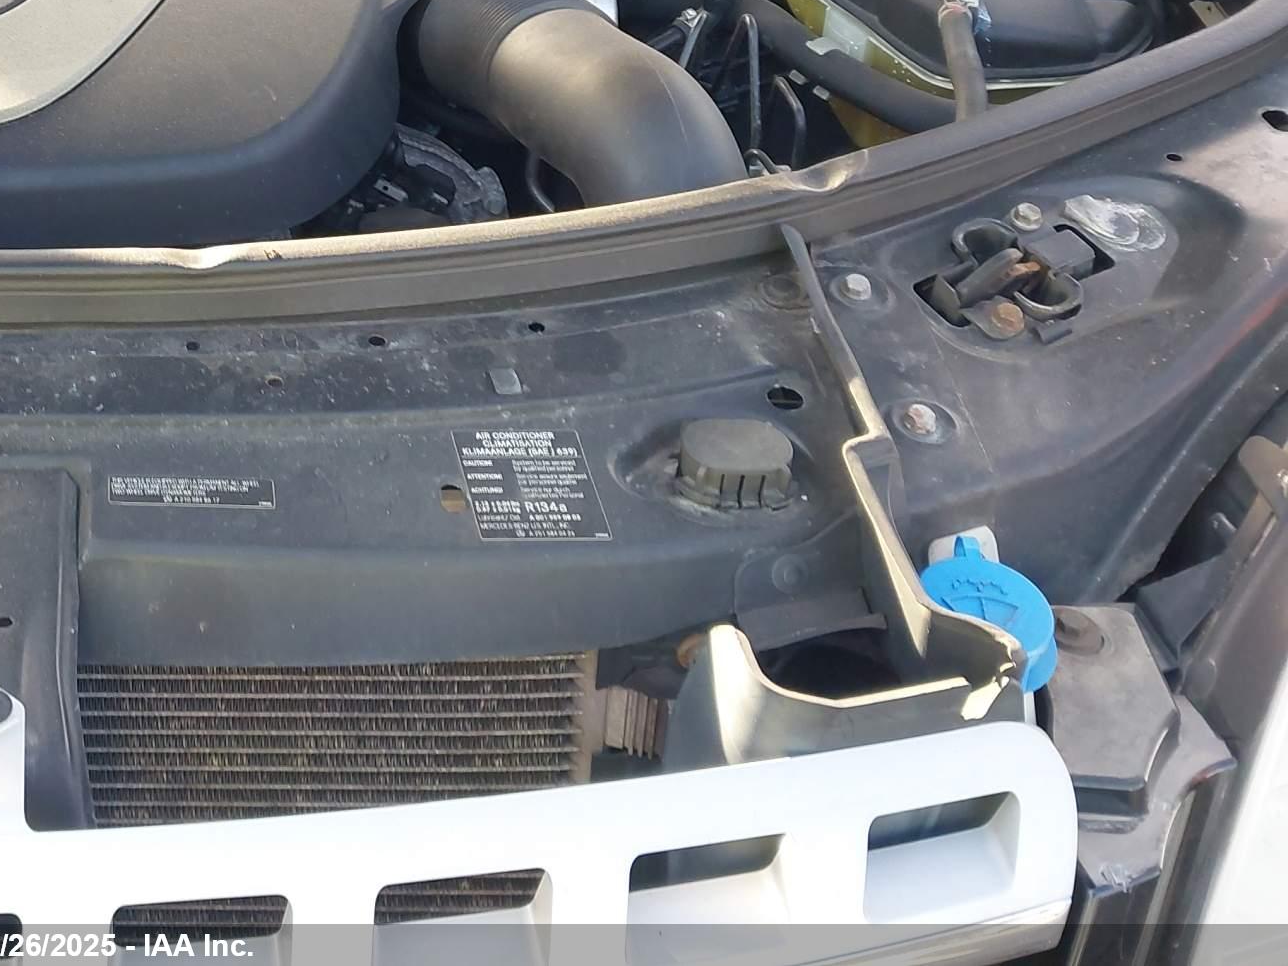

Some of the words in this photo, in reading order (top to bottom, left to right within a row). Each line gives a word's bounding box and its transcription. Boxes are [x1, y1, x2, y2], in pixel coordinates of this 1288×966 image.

[475, 431, 491, 440] AIR
[492, 431, 555, 440] CONDITIONER
[482, 439, 553, 448] CLIMATISATION
[462, 447, 527, 456] KLIMAANLAGE
